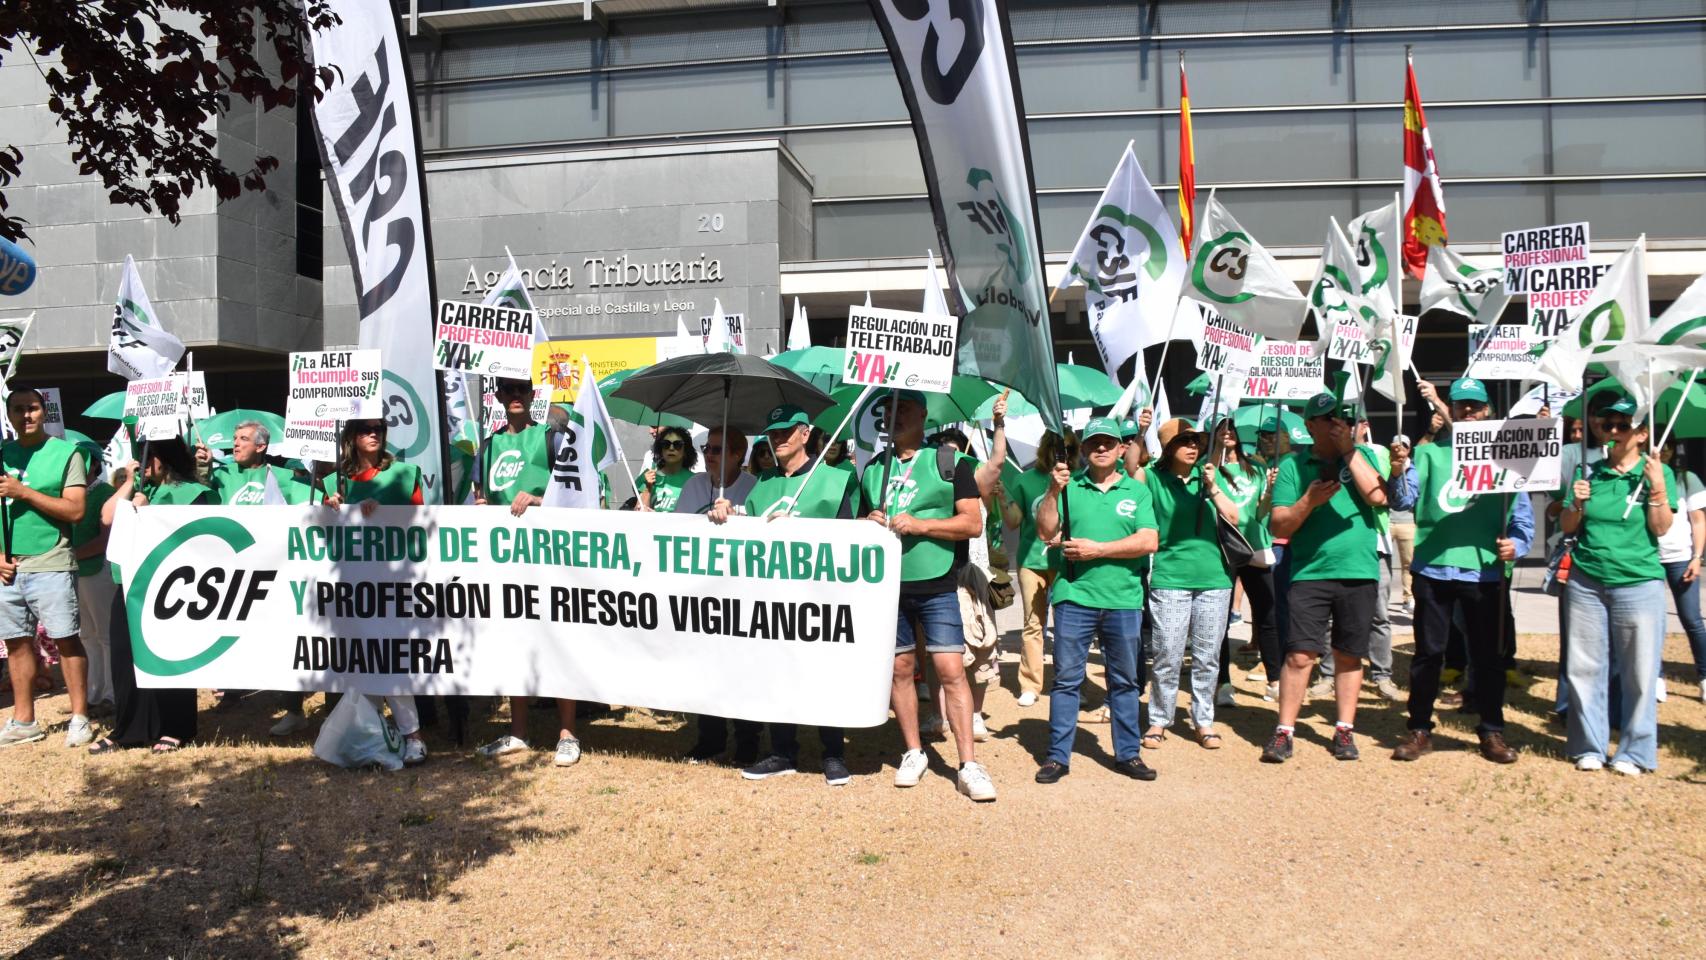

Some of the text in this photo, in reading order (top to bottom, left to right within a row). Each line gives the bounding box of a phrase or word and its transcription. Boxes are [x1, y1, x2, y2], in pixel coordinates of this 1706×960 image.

[697, 213, 724, 232] 20
[1504, 225, 1586, 254] CARRERA
[1090, 224, 1138, 303] CSIF
[1210, 247, 1249, 280] CS
[1504, 246, 1586, 268] PROFESIONAL
[462, 252, 724, 299] Agncia Tributaria
[1531, 265, 1612, 292] CARRE
[585, 304, 601, 315] de
[604, 302, 650, 314] Castilla
[653, 303, 661, 315] y
[664, 299, 695, 312] León
[1531, 290, 1593, 308] PROFES
[440, 302, 533, 335] CARRERA
[701, 316, 742, 336] CARA
[851, 315, 954, 339] REGULACIÓN DEL
[438, 324, 532, 350] PROFESIONAL
[1204, 326, 1252, 352] PROFESIONAL
[1495, 326, 1521, 338] AEAT
[850, 331, 953, 357] TELETRABAJO
[1300, 345, 1313, 355] DE
[320, 352, 353, 368] AEAT
[1260, 356, 1294, 367] RIESGO
[361, 371, 379, 381] sus
[1248, 366, 1282, 377] GILANCIA
[1285, 367, 1322, 378] ADUANERA
[128, 380, 163, 395] PROFESIÓN
[164, 380, 173, 392] DE
[136, 394, 161, 406] RIESGO
[161, 392, 179, 403] PARA
[150, 404, 177, 416] ADUANERA
[1455, 427, 1560, 444] REGULACIÓN DEL
[554, 425, 582, 492] CSIF
[1455, 442, 1559, 461] TELETRABAJO
[496, 460, 524, 477] CSIF
[287, 526, 885, 583] ACUERDO DE CARRERA, TELETRABAJO
[153, 565, 278, 621] CSIF
[290, 576, 855, 644] Y PROFESIÓN DE RIESGO VIGILANCIA
[293, 636, 454, 674] ADUANERA
